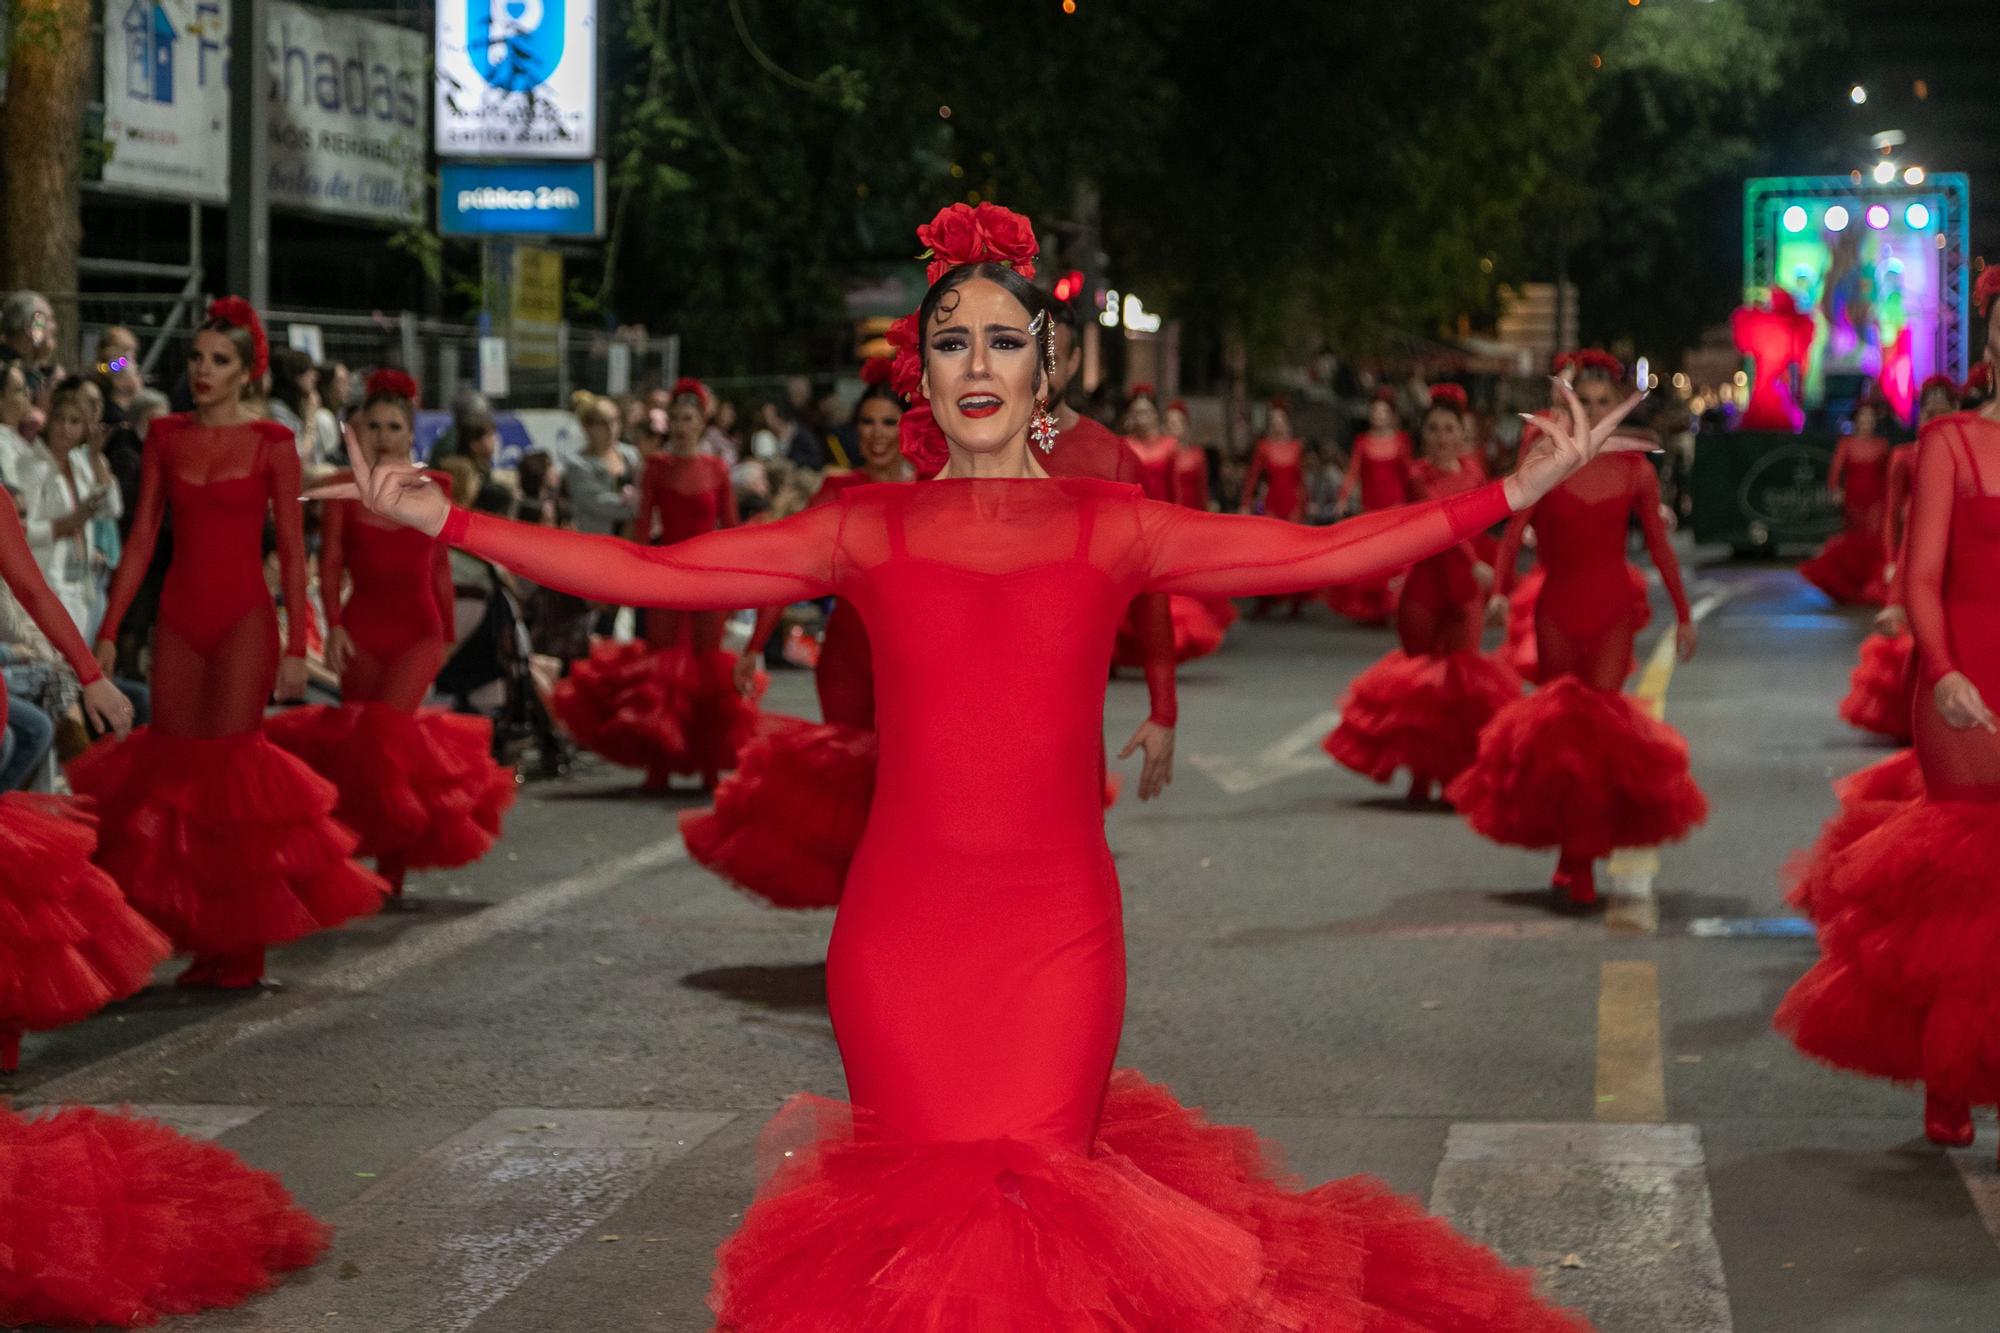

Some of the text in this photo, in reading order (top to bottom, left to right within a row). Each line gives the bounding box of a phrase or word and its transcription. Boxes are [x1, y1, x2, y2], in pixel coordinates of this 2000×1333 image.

[197, 3, 418, 127] Fhadas
[457, 185, 580, 213] público 24h
